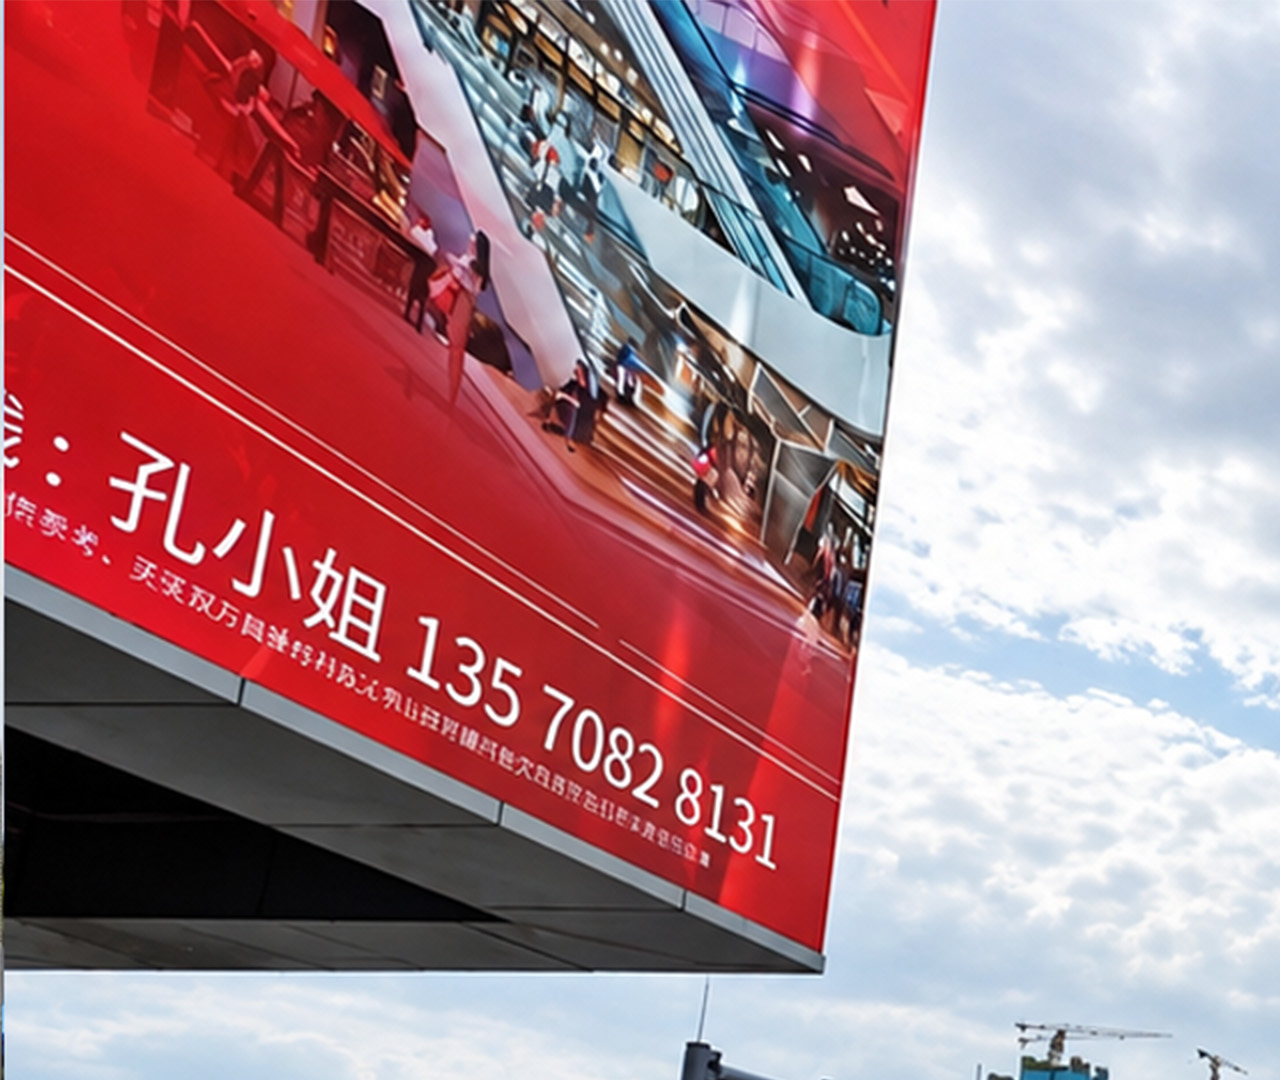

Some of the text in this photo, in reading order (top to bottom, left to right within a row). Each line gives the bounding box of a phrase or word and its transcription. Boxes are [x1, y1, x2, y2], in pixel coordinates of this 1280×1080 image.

[405, 615, 523, 728] 135
[543, 684, 665, 809] 7082
[674, 767, 778, 871] 8131
